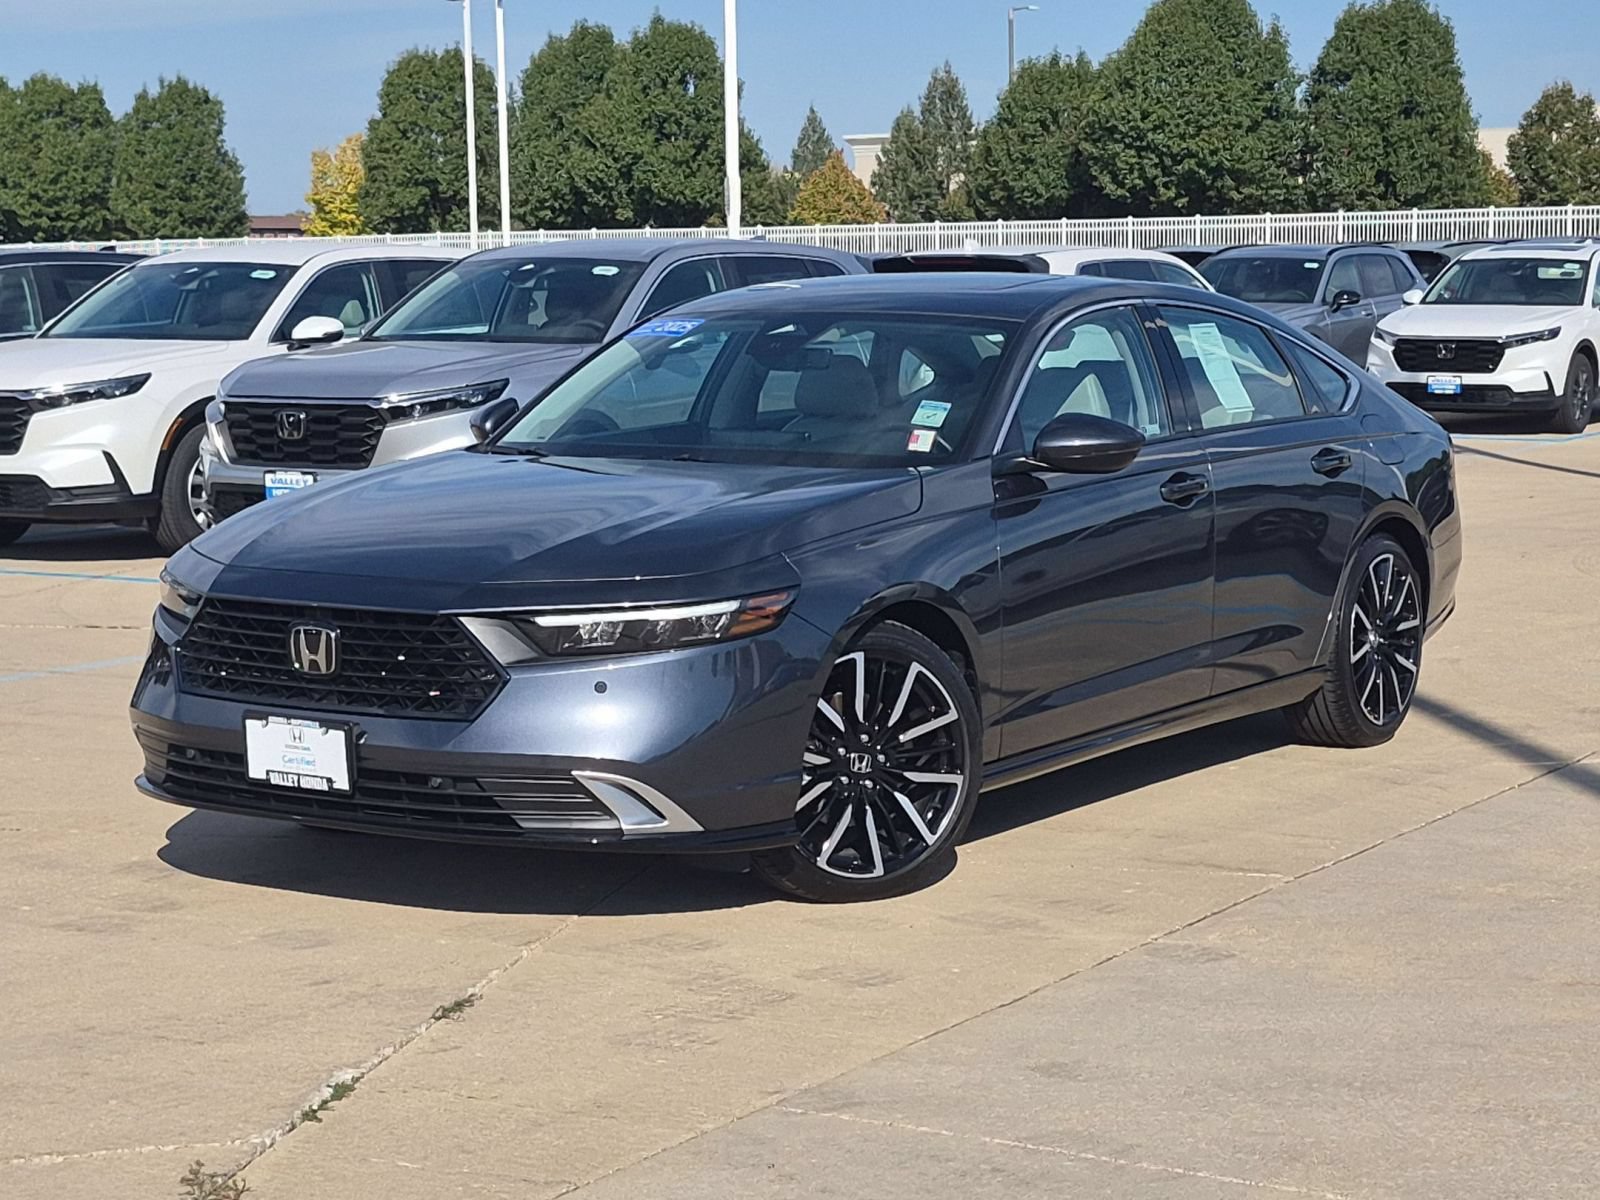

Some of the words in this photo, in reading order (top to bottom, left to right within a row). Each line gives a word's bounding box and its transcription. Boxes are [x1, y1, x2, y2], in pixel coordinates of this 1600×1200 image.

[270, 476, 309, 486] VALLEY
[281, 754, 316, 766] Certified
[268, 771, 299, 787] VALLEY
